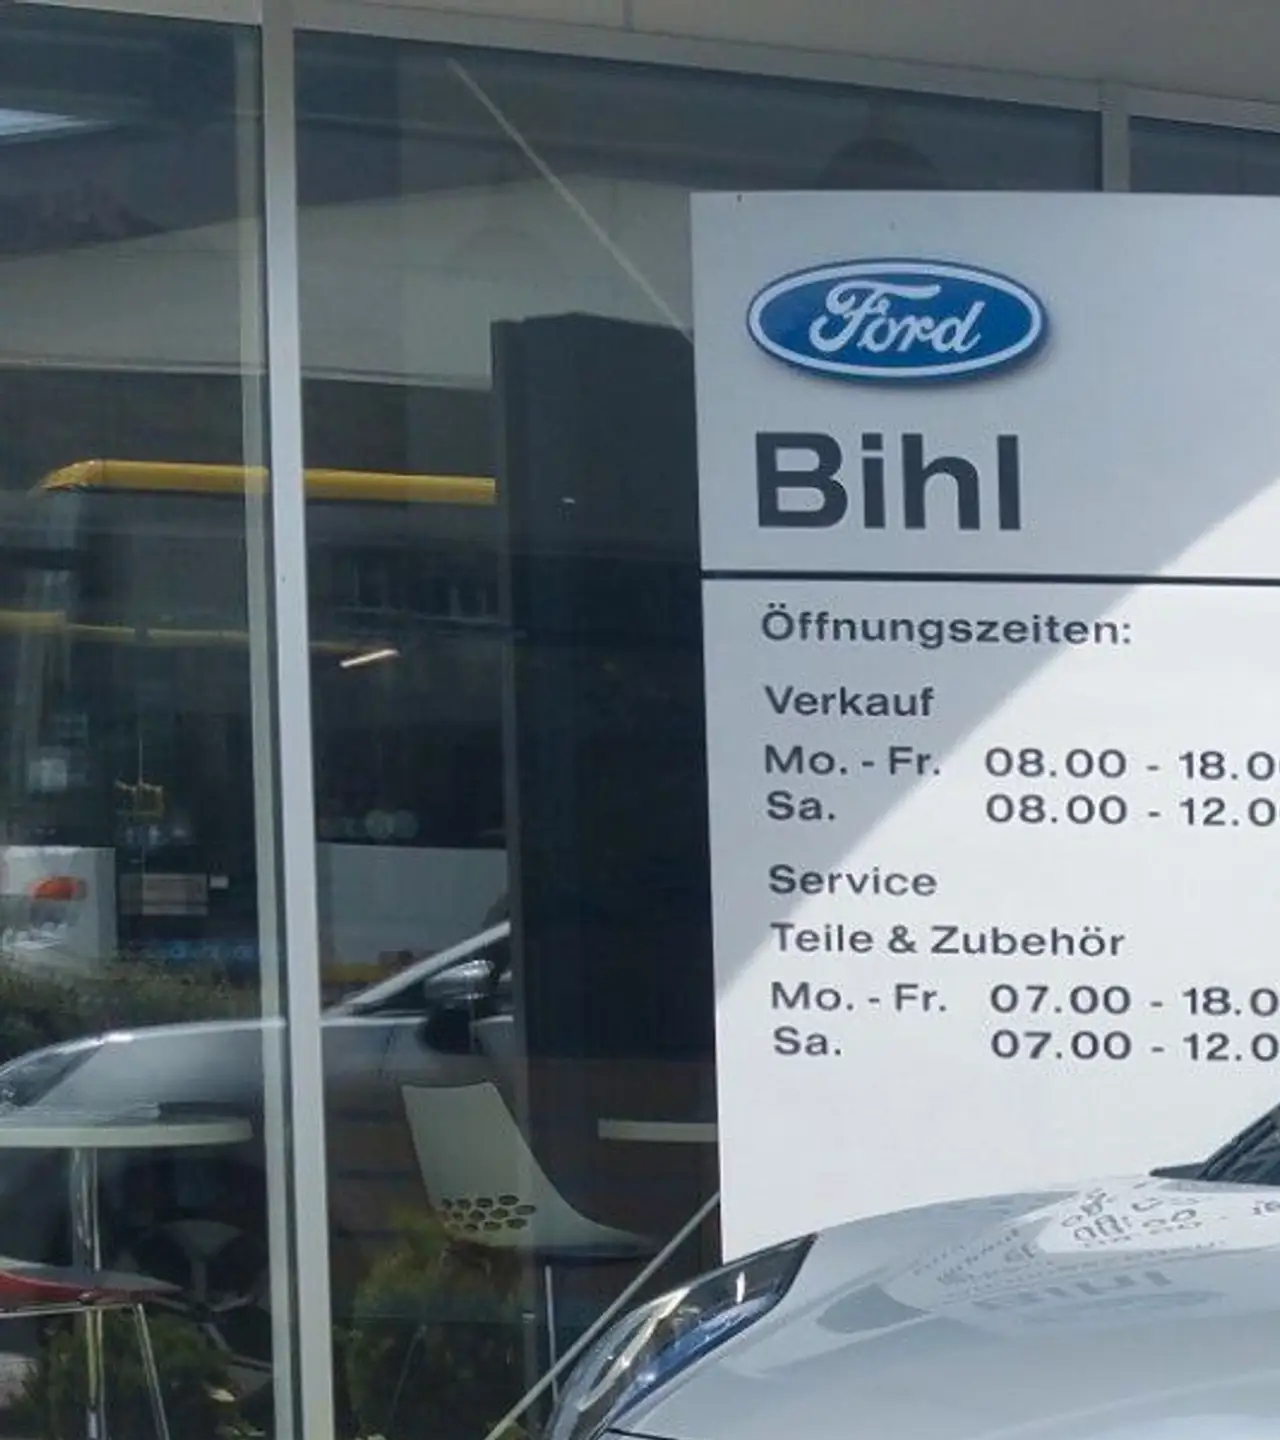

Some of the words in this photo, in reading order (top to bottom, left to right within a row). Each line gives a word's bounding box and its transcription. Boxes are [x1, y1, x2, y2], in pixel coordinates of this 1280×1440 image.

[808, 279, 987, 354] Ford
[755, 431, 1021, 531] Bihl
[761, 602, 1131, 650] Öffnungszeiten:
[764, 685, 935, 717] Verkauf
[765, 744, 848, 775] Mo.
[888, 745, 941, 776] Fr.
[984, 746, 1127, 779] 08.00
[766, 790, 836, 821] Sa.
[985, 793, 1128, 826] 08.00
[769, 863, 938, 897] Service
[769, 922, 874, 954] Teile
[887, 924, 918, 954] &
[930, 924, 1126, 957] Zubehör
[771, 981, 854, 1011] Mo.
[894, 982, 947, 1013] Fr.
[990, 983, 1132, 1016] 07.00
[773, 1025, 842, 1056] Sa.
[990, 1028, 1132, 1061] 07.00
